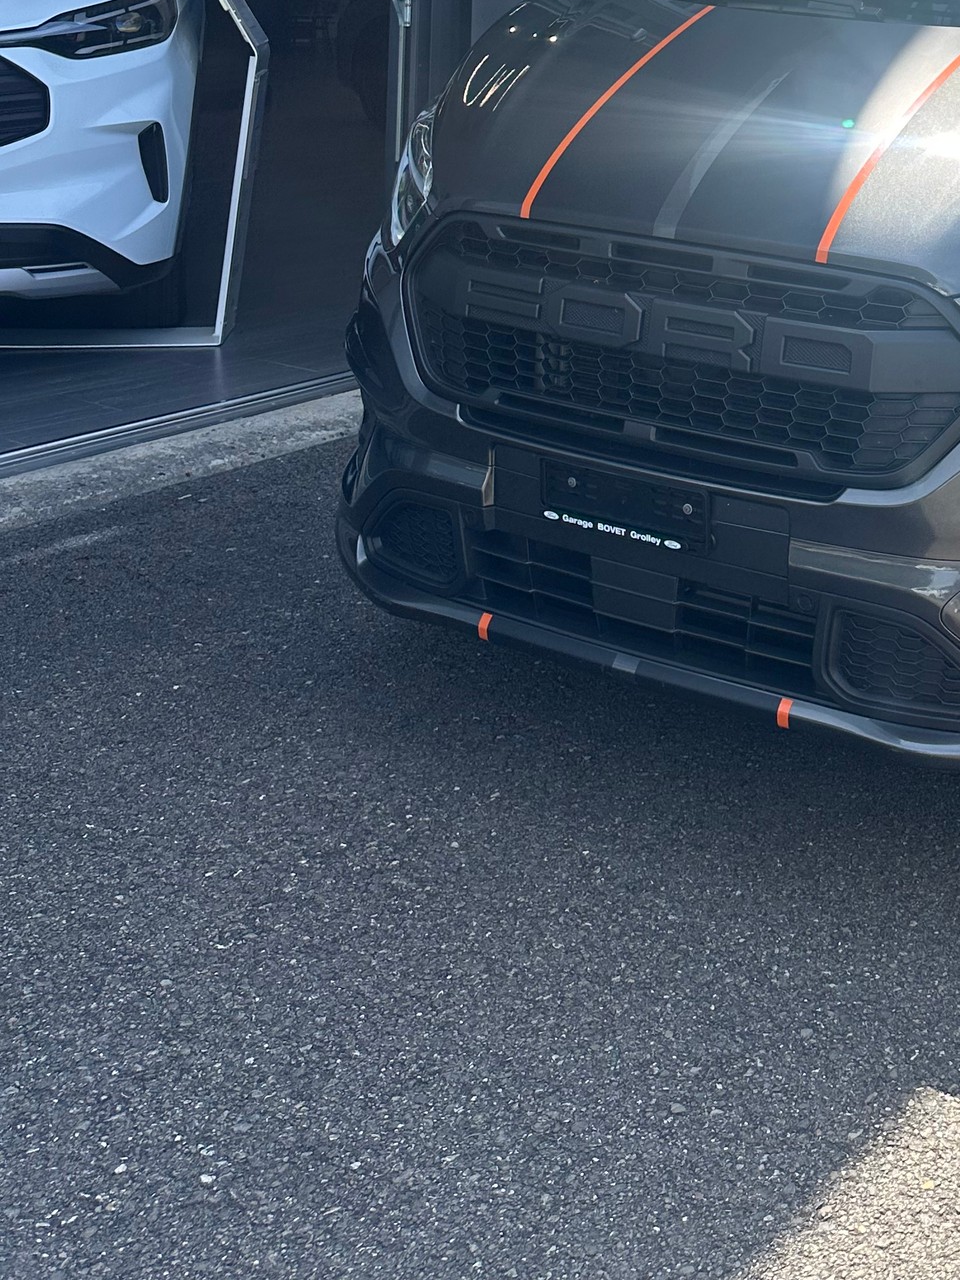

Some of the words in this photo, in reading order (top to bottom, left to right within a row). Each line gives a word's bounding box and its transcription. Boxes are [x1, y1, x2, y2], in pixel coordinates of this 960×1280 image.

[455, 266, 869, 391] FORD
[562, 514, 594, 529] Garage
[597, 523, 626, 536] BOVET
[630, 531, 661, 546] Grolley
